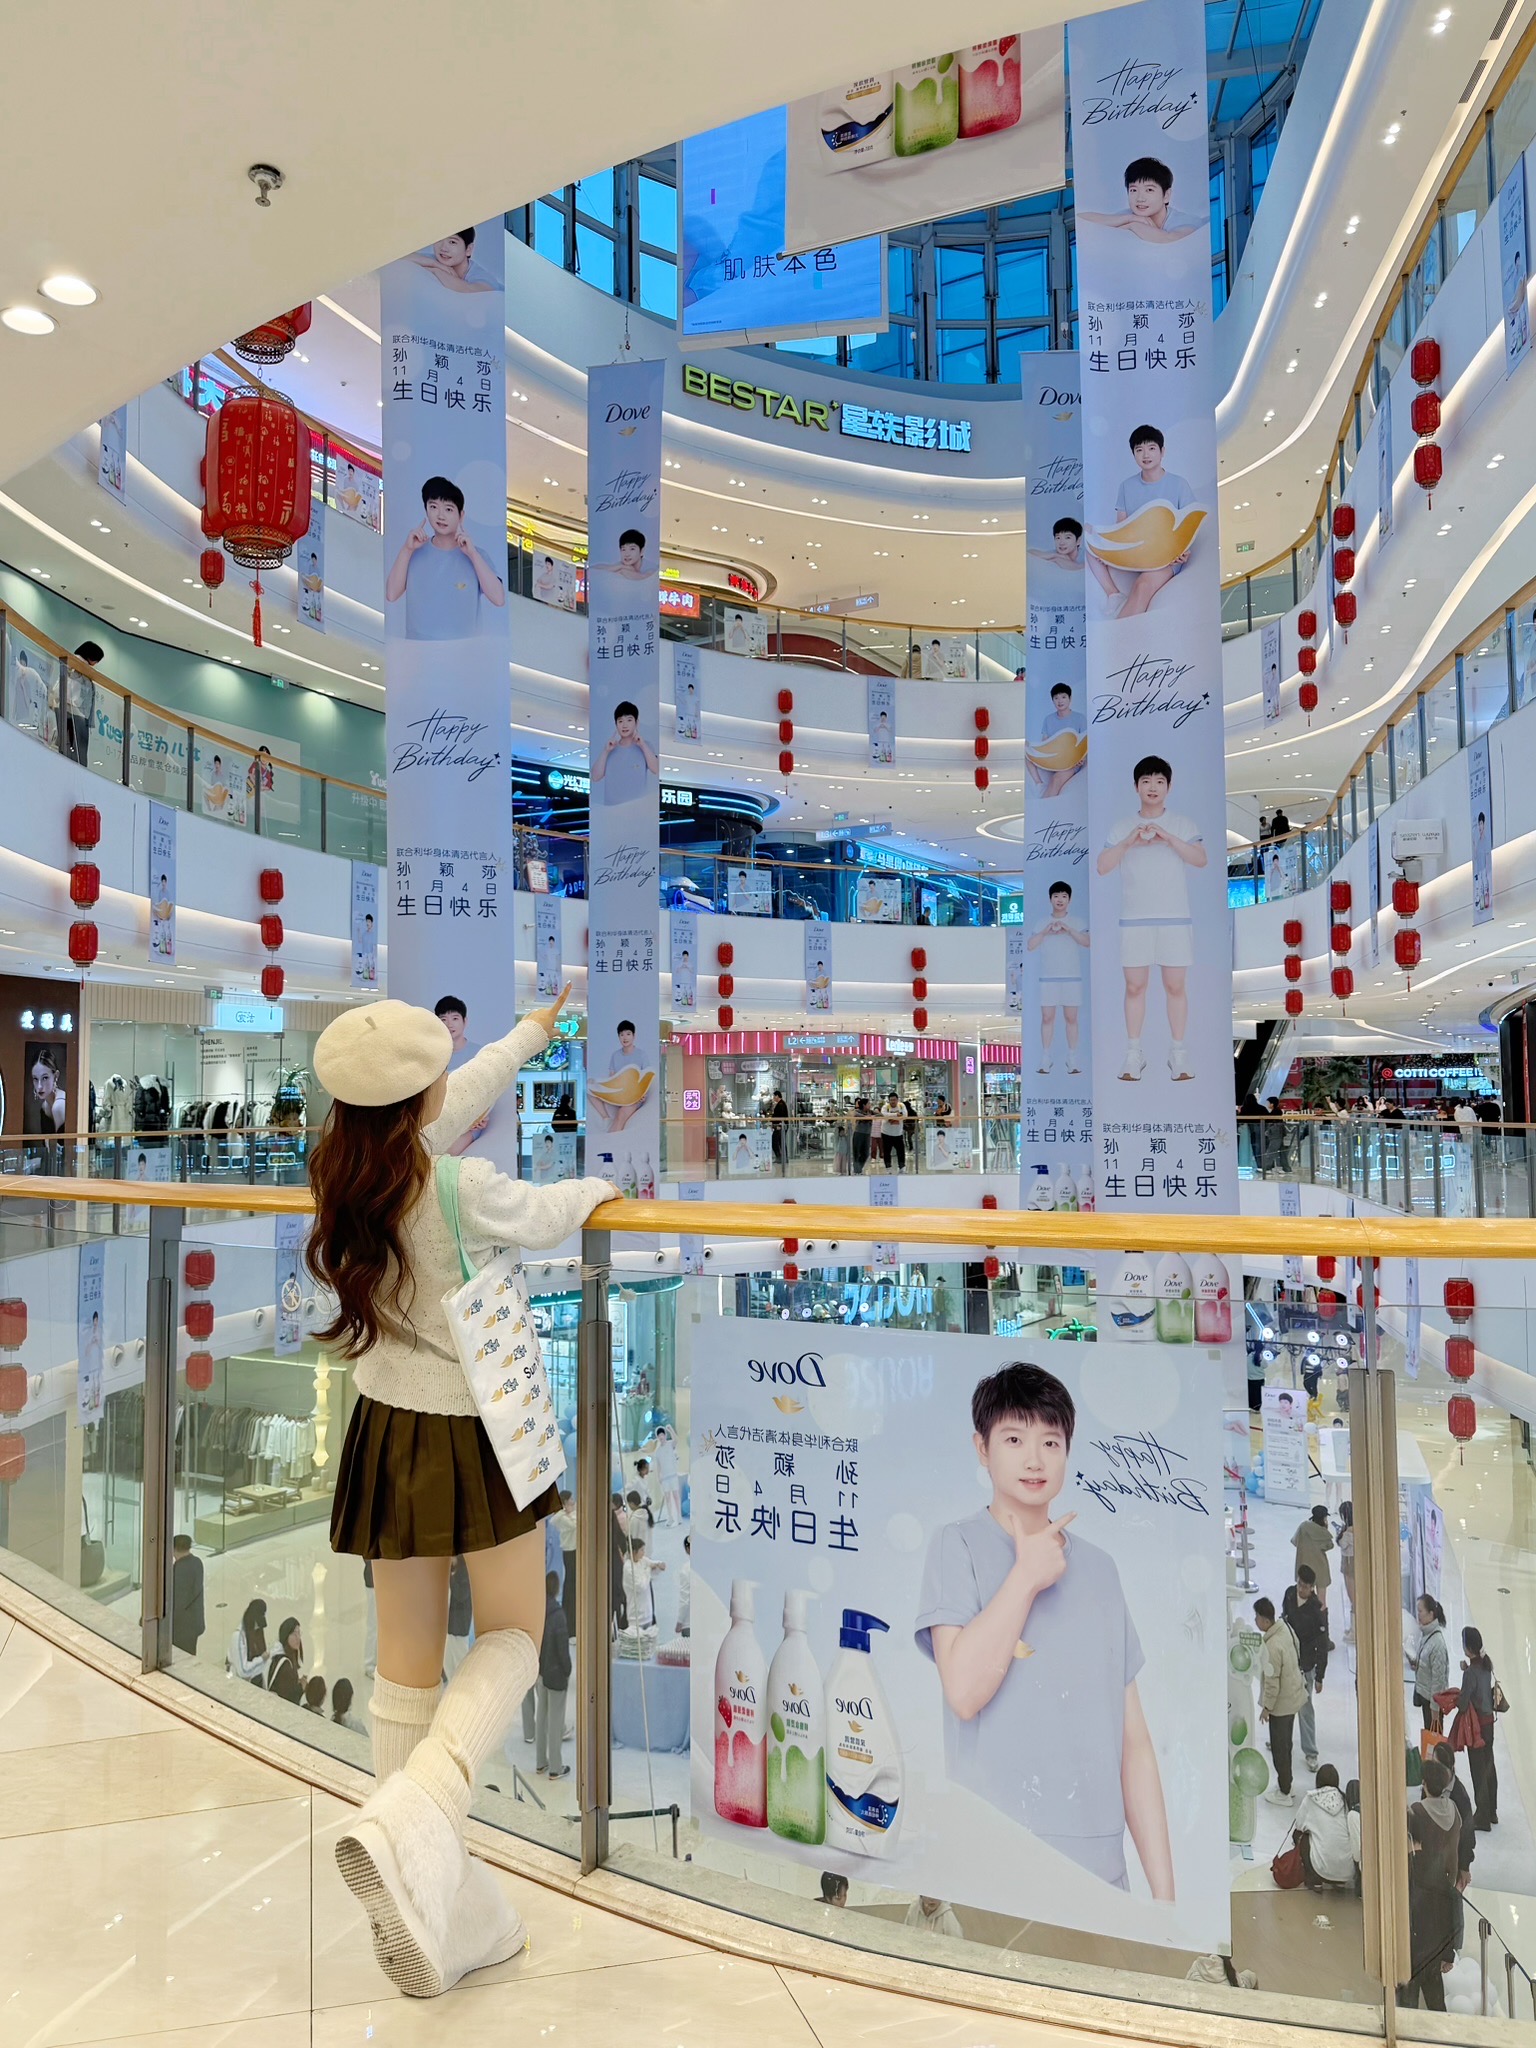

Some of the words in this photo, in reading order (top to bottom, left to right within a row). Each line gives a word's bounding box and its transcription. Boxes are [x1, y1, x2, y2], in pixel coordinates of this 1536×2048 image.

[1097, 57, 1183, 94] Happy
[1082, 90, 1193, 129] Birthday
[722, 247, 838, 281] 肌肤本色
[1087, 298, 1195, 312] 联合利华身体清洁代言人
[1088, 313, 1195, 331] 孙颖莎
[392, 334, 492, 358] 联合利华身体清洁代言人
[1088, 331, 1195, 347] 11月4日
[392, 348, 491, 376] 孙颖莎
[1088, 348, 1195, 374] 生日快乐
[393, 365, 491, 391] 11月4日
[393, 379, 492, 413] 生日快乐
[682, 363, 830, 431] BESTAR
[1039, 386, 1082, 406] Dov
[604, 403, 651, 423] Dove
[840, 403, 972, 453] 星轶影城
[605, 469, 652, 489] Happy
[1030, 477, 1085, 501] Birthda
[595, 487, 655, 513] Birthday
[597, 621, 654, 635] 孙颖莎
[597, 642, 655, 660] 生日快乐
[1106, 654, 1195, 693] Happy
[1092, 692, 1203, 728] Birthday
[407, 708, 488, 743] Happy
[392, 742, 496, 782] Birthday
[661, 789, 693, 806] 乐园
[1034, 820, 1087, 842] Happy
[396, 847, 497, 861] 联合利华身体清洁代言人
[604, 844, 650, 867] Happy
[1026, 841, 1089, 866] Birthday
[396, 861, 497, 878] 孙颖莎
[594, 866, 654, 888] Birthday
[396, 880, 497, 895] 11月4日
[397, 895, 497, 918] 生日快乐
[596, 937, 653, 949] 孙颖莎
[595, 958, 653, 974] 生日快乐
[1394, 1068, 1428, 1078] COTTI
[1428, 1067, 1474, 1078] COFFEE
[1026, 1107, 1092, 1117] 孙颖莎
[1026, 1129, 1093, 1143] 生日快乐
[1102, 1123, 1215, 1134] 联合利华身体清洁代言人
[1103, 1137, 1215, 1154] 孙颖莎
[1103, 1157, 1215, 1172] 11月4日
[601, 1171, 615, 1180] Dove
[1036, 1184, 1051, 1192] Dove
[1105, 1175, 1217, 1198] 生日快乐
[1124, 1271, 1148, 1281] Dove
[1164, 1279, 1182, 1287] Dove
[1200, 1279, 1219, 1287] Dove
